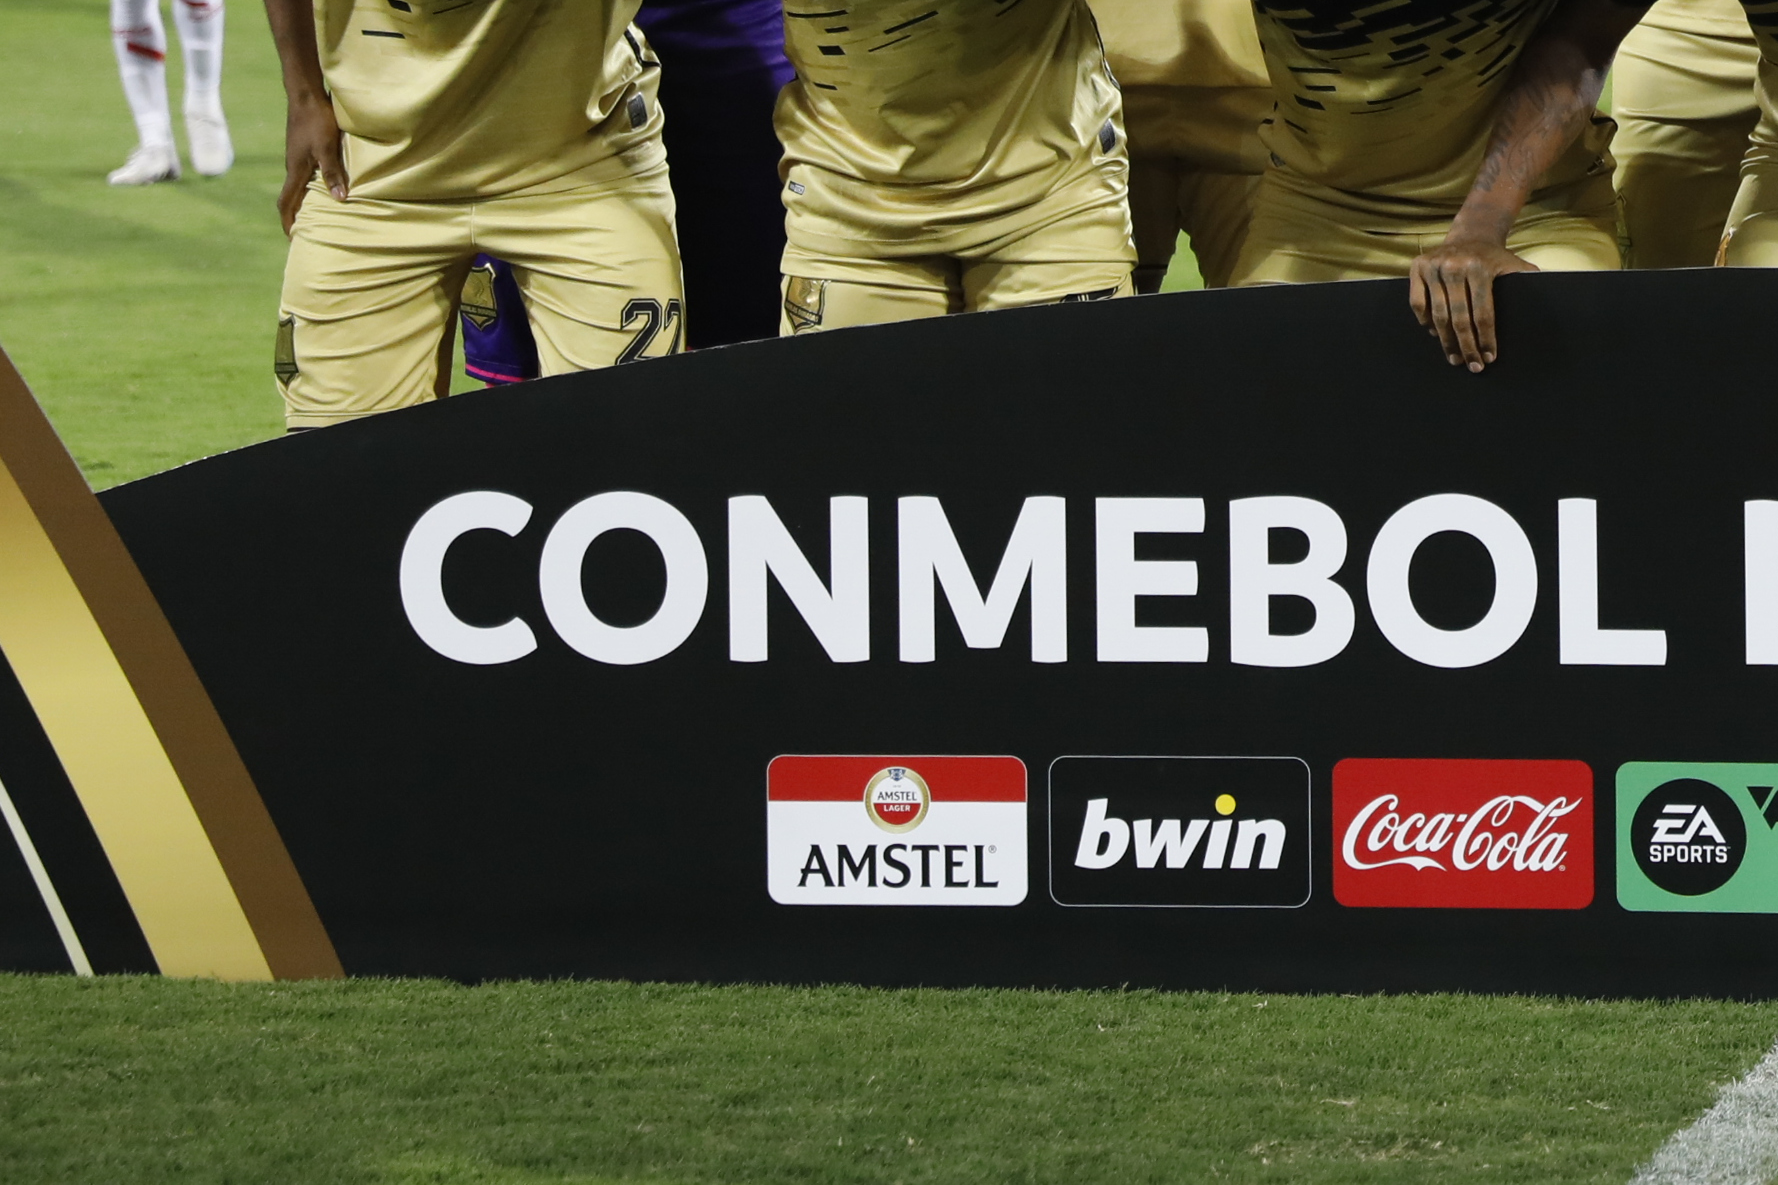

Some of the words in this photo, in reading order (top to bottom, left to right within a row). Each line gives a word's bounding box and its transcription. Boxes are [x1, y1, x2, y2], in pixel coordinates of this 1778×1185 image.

[399, 490, 1668, 669] CONMEBOL
[877, 790, 918, 802] AMSTEL
[883, 804, 911, 812] LAGER
[1074, 793, 1286, 870] bwin
[1342, 793, 1583, 872] Coca-Cola
[1650, 804, 1727, 844] EA
[797, 843, 999, 888] AMSTEL
[1649, 844, 1728, 864] SPORTS
